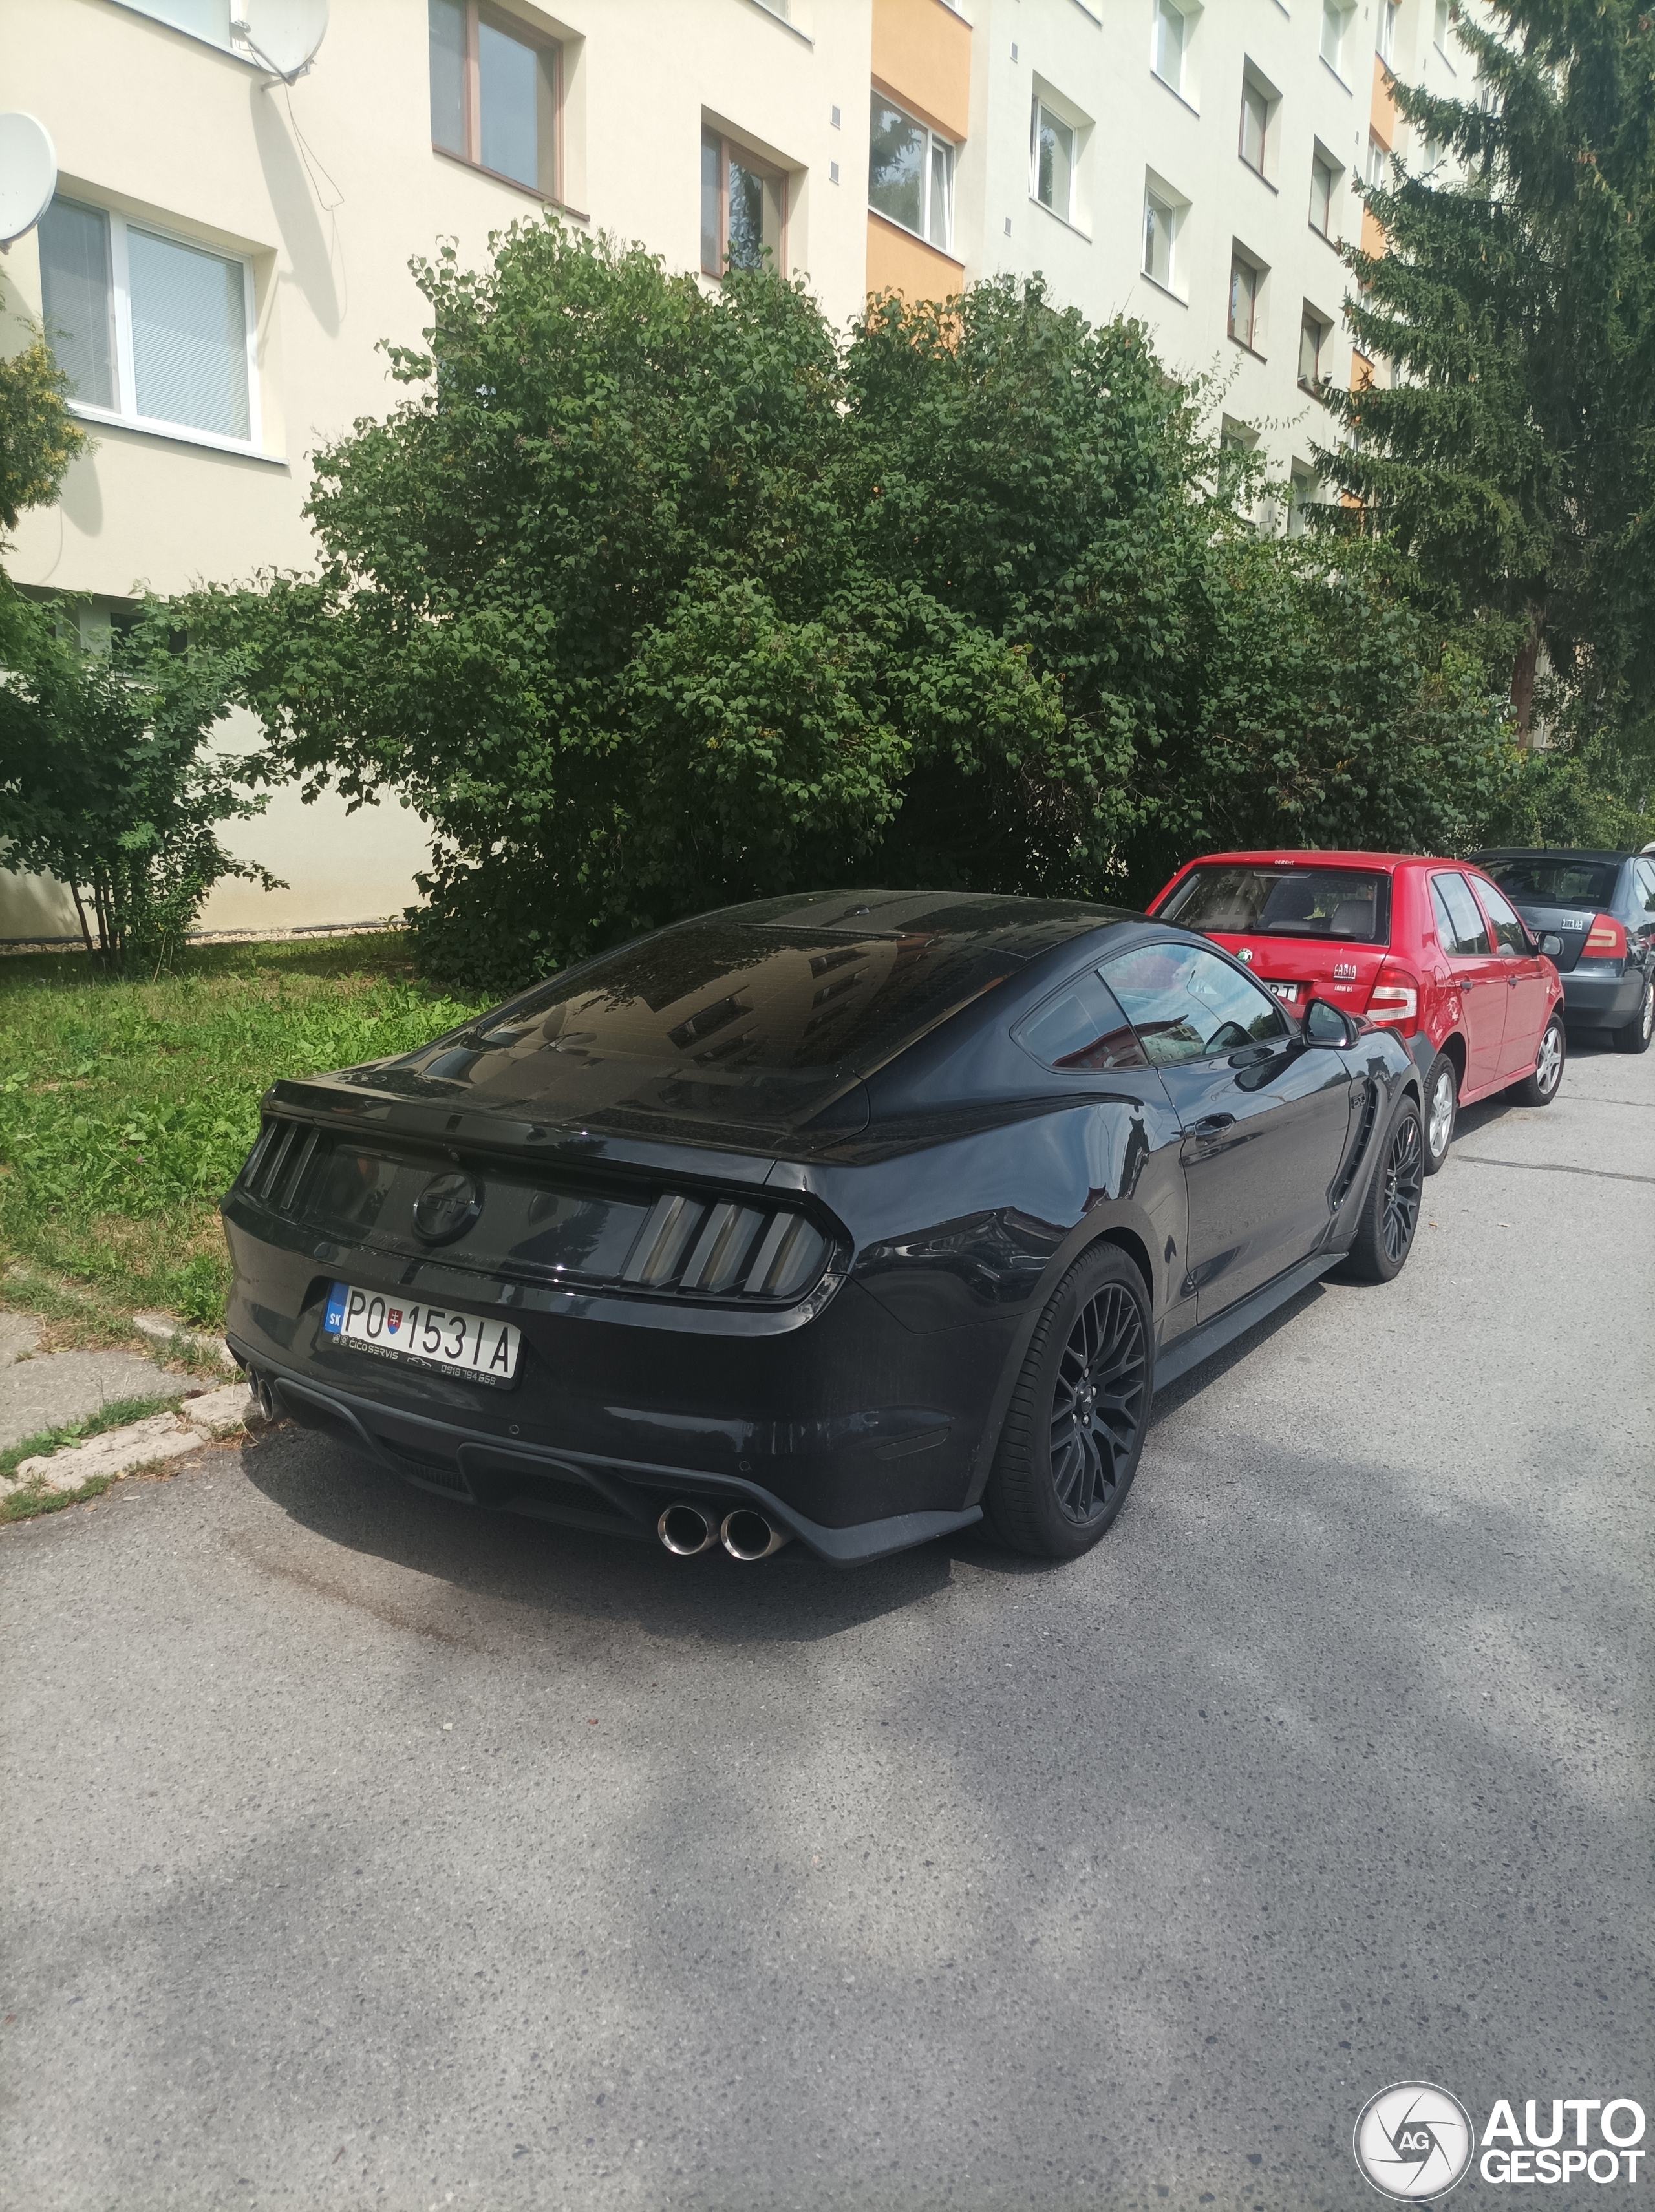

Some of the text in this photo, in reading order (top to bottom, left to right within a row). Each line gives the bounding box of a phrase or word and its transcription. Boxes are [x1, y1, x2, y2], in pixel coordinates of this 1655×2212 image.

[1334, 963, 1356, 977] FABIA
[329, 1313, 341, 1326] SK
[345, 1290, 386, 1338] PO
[367, 1345, 399, 1360] SERVIS
[440, 1364, 461, 1376] 0918
[462, 1369, 478, 1381] 794
